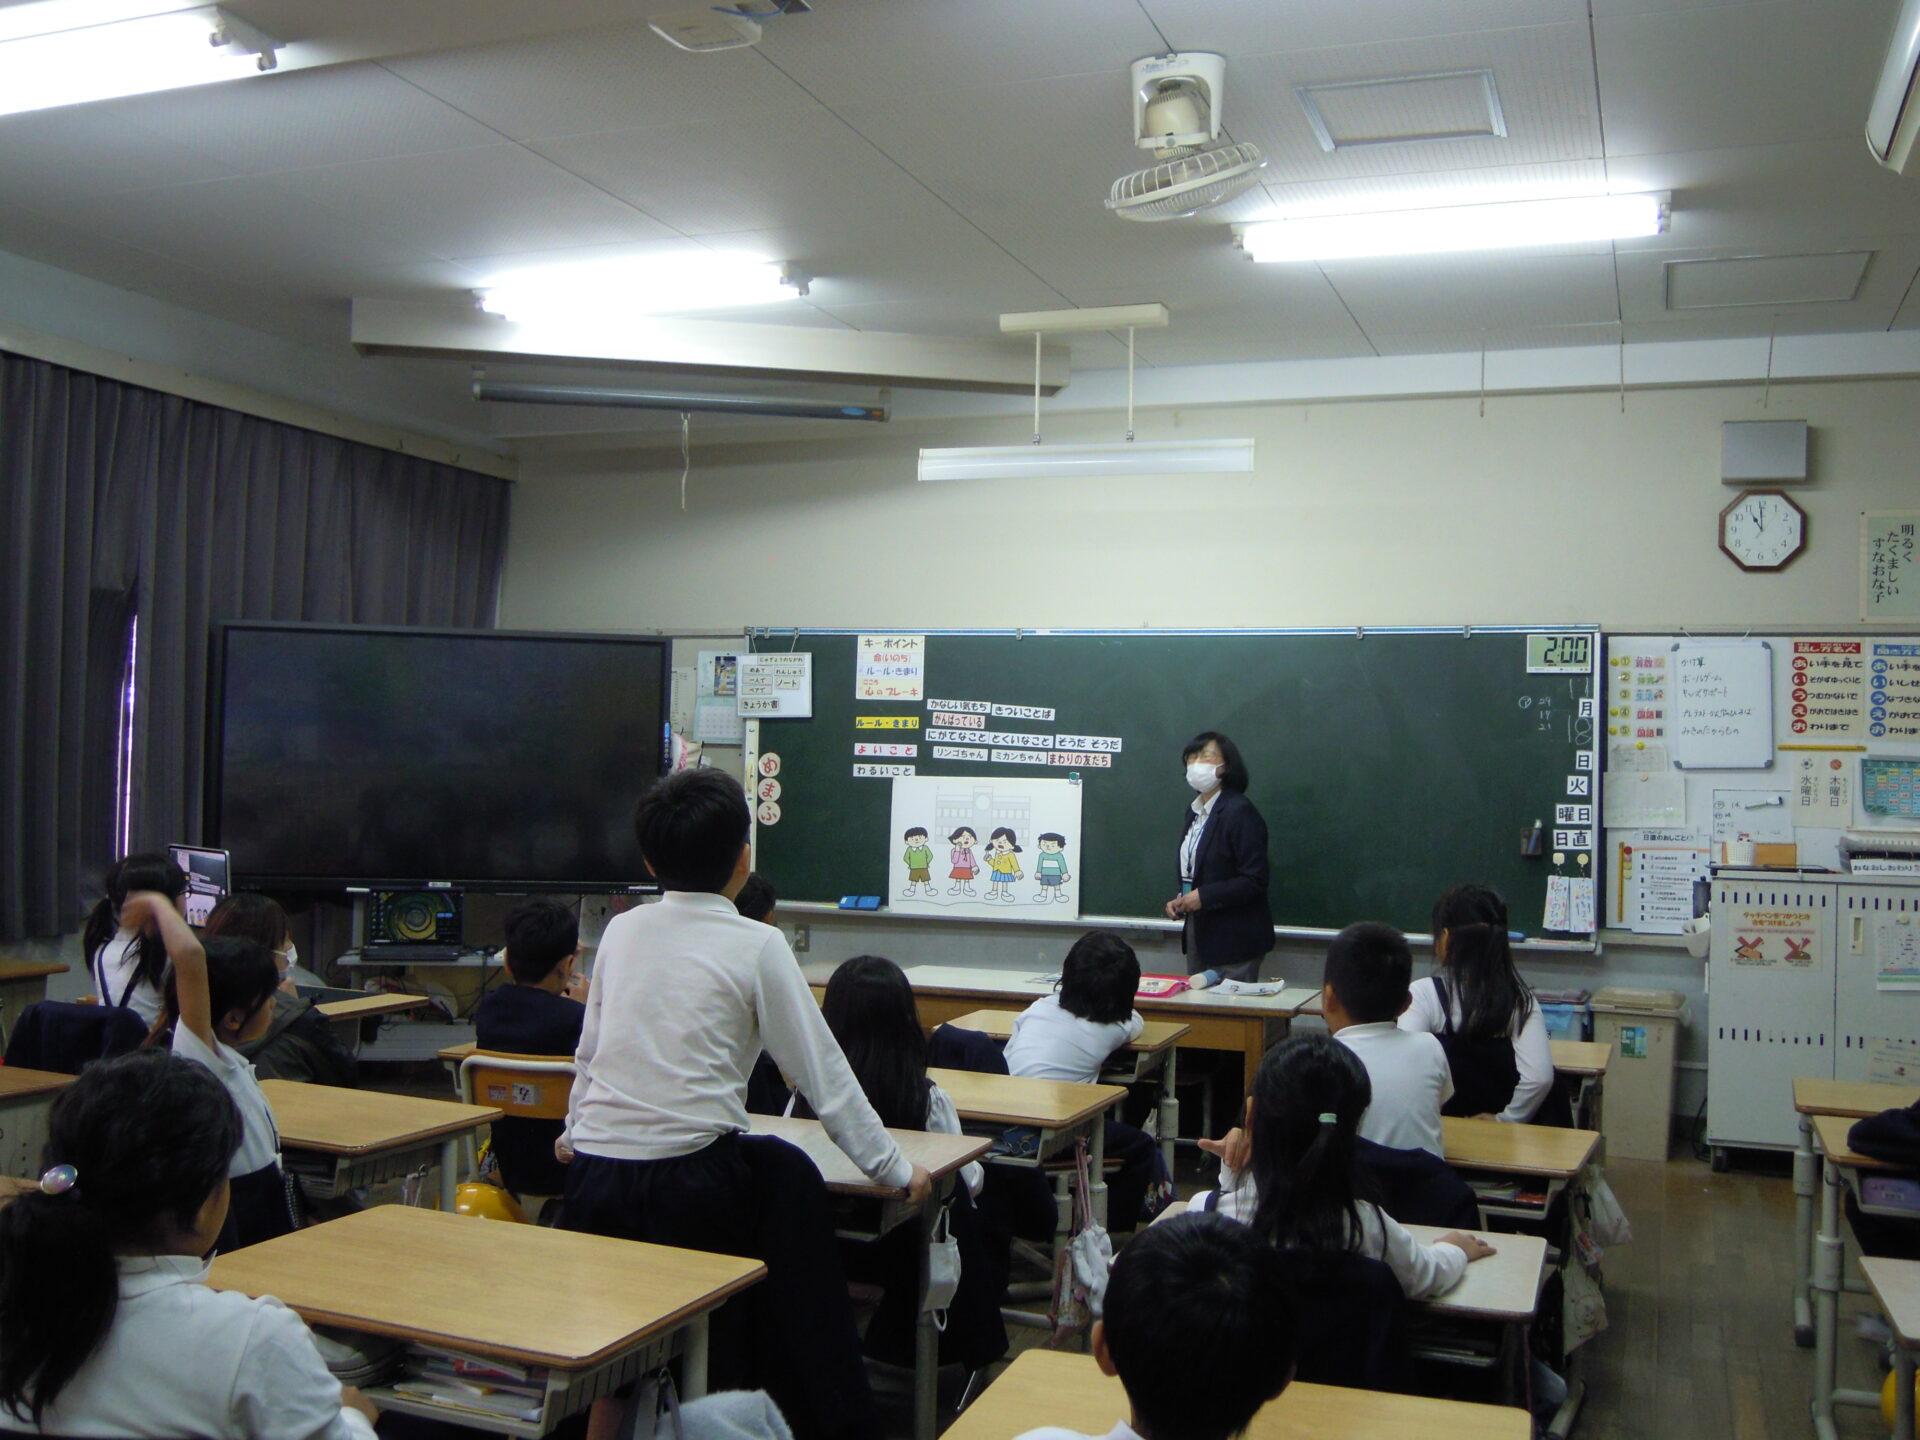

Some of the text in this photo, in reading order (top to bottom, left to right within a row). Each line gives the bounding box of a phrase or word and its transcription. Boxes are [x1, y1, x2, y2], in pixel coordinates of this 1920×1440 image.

[1901, 524, 1914, 562] 明るく
[1887, 531, 1899, 595] たくましい
[1872, 538, 1885, 604] すなおな子
[864, 638, 918, 648] キーポイント
[1543, 636, 1588, 663] 2:00
[777, 679, 797, 687] ノート
[743, 700, 779, 709] きょうか書
[930, 701, 987, 712] かなしい気もち
[1580, 702, 1592, 716] 月
[994, 706, 1052, 719] きついことば
[857, 719, 918, 728] ルール・きまり
[934, 714, 982, 728] がんばっている
[927, 731, 986, 743] にがてなこと
[992, 734, 1050, 747] とくいなこと
[1058, 737, 1120, 750] そうだ そうだ
[857, 745, 913, 756] よいこと
[937, 749, 984, 760] リンゴちゃん
[995, 751, 1043, 763] ミカンちゃん
[762, 757, 778, 774] め
[1049, 754, 1109, 767] まわりの友だち
[1577, 754, 1590, 768] 日
[857, 766, 912, 776] わるいこと
[762, 783, 775, 798] ま
[1569, 777, 1586, 793] 火
[1801, 775, 1812, 806] 水曜日
[1829, 776, 1840, 807] 木曜日
[760, 805, 778, 821] ふ
[1558, 806, 1591, 822] 曜日
[1556, 830, 1589, 847] 日直
